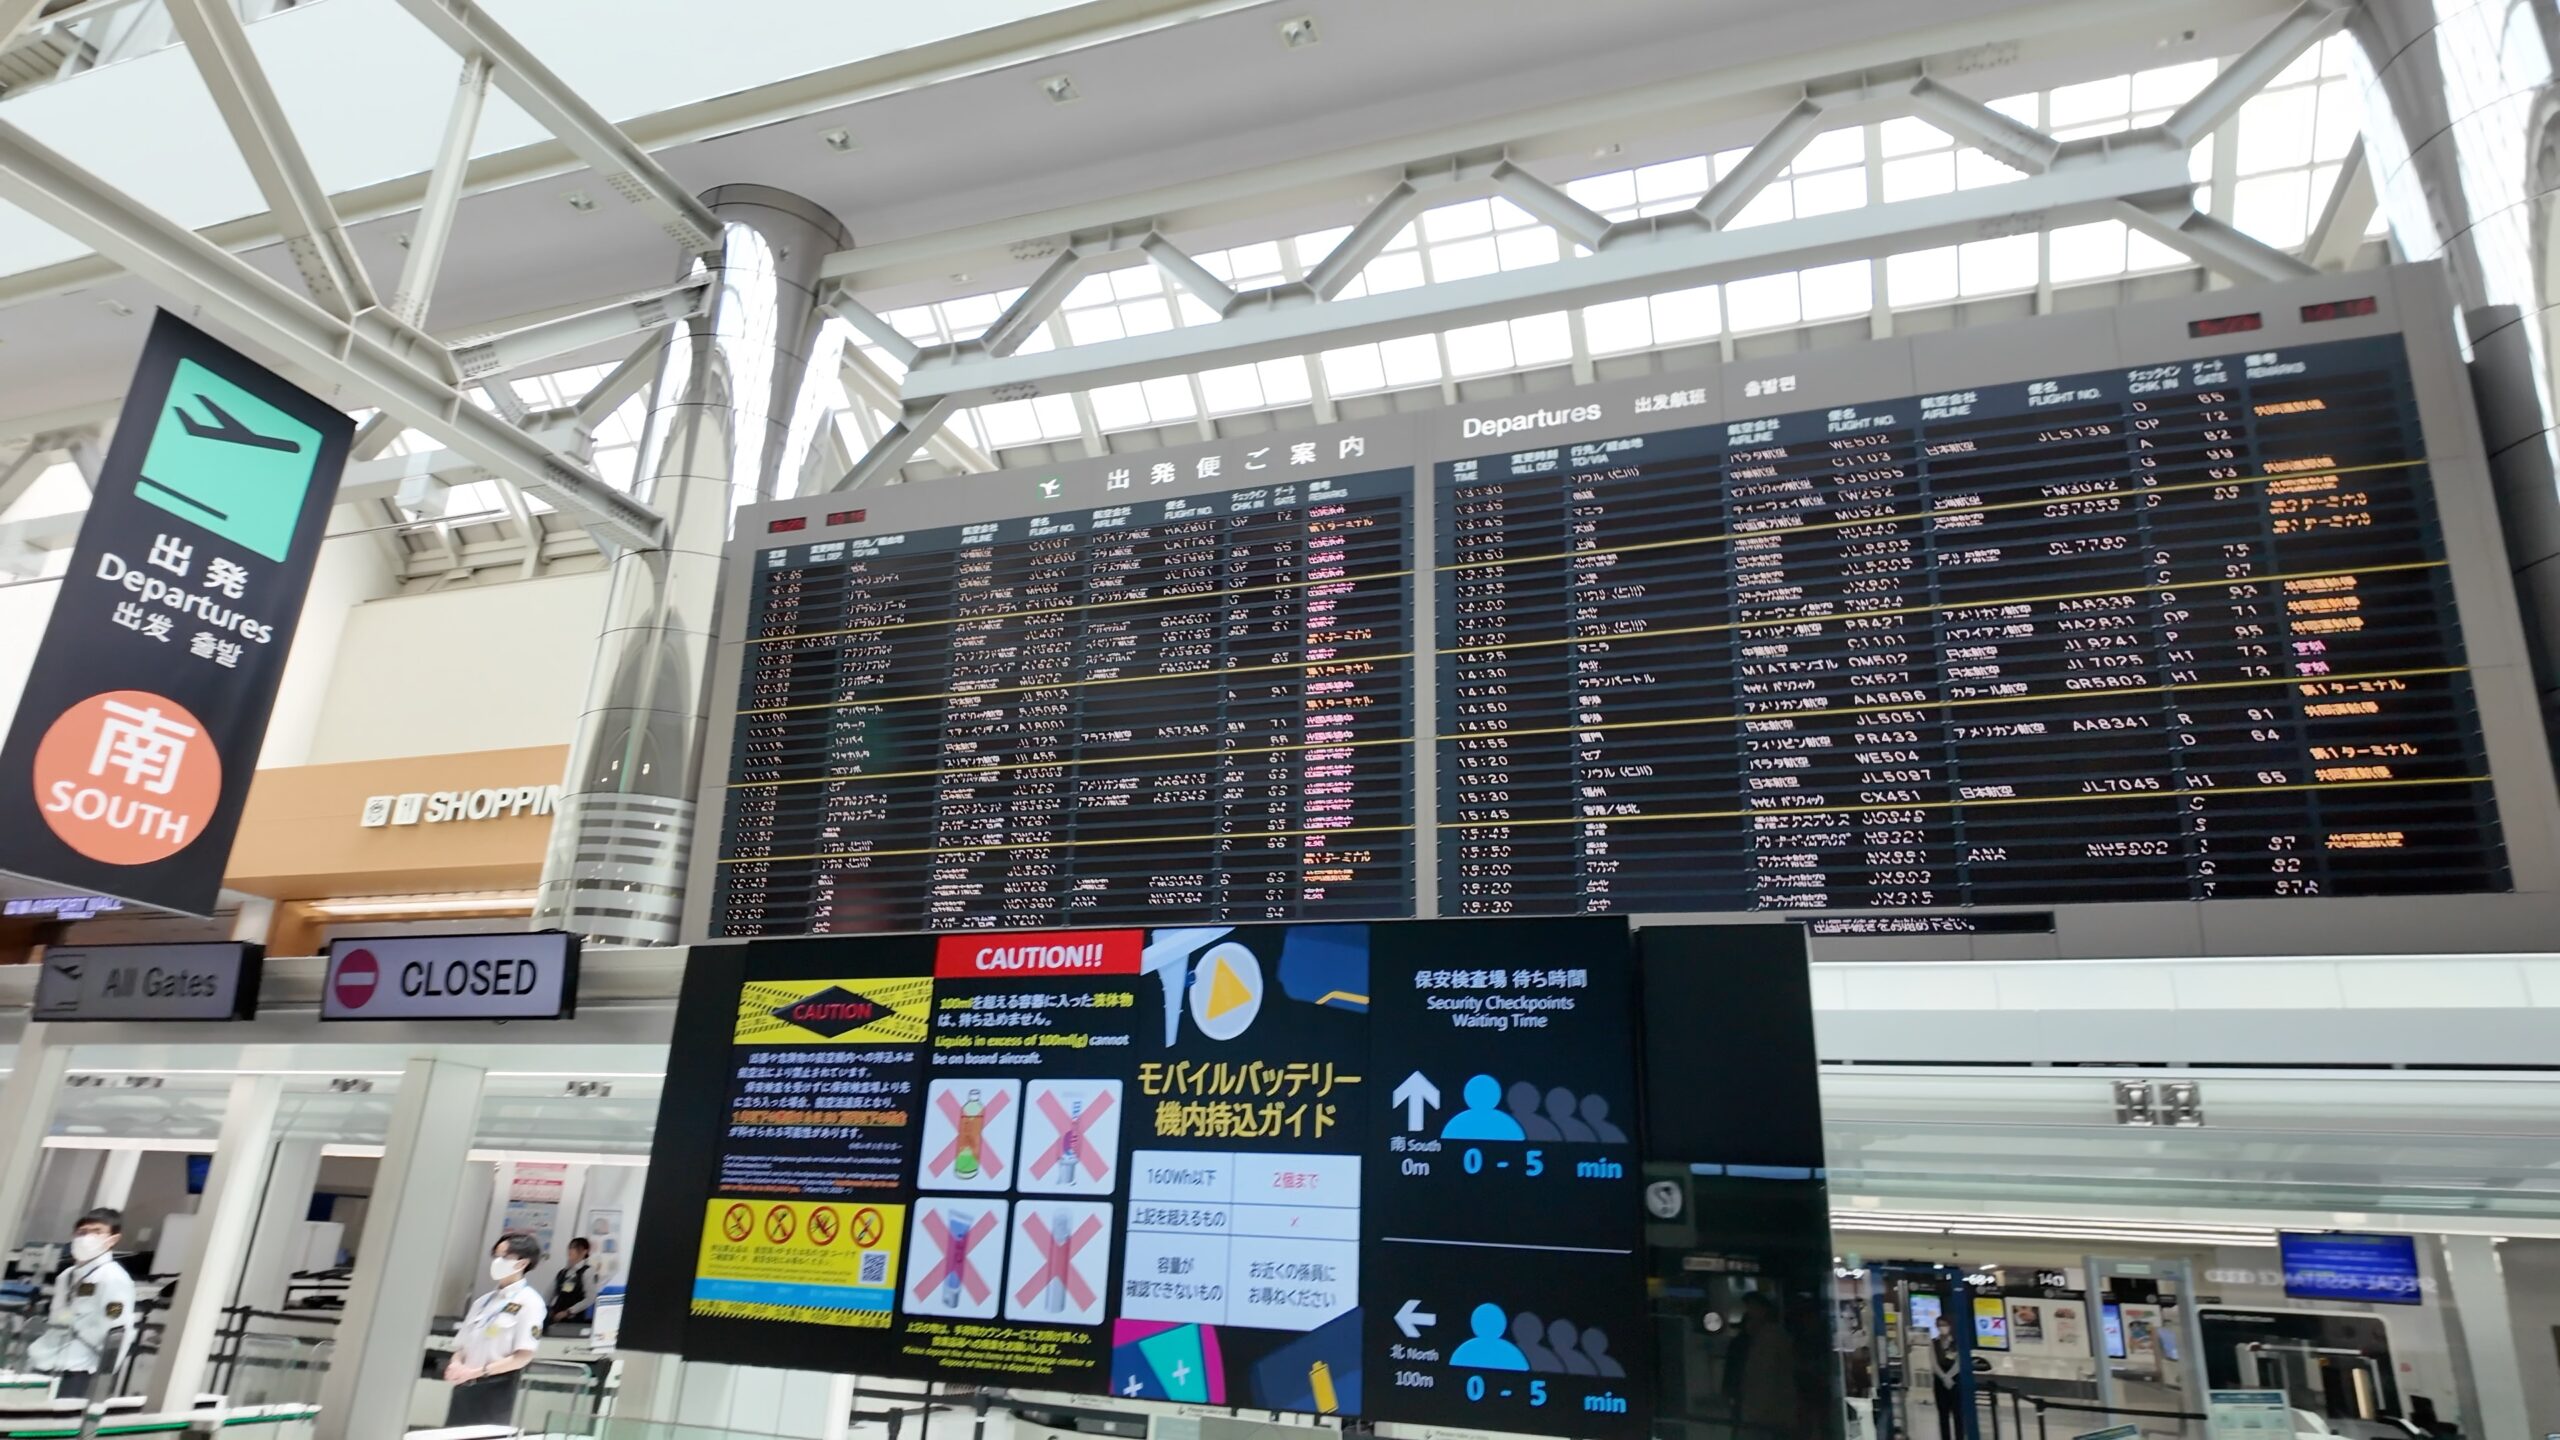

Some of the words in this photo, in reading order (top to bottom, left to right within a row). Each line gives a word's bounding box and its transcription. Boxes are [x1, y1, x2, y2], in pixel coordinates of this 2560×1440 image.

[1462, 404, 1602, 440] Departures
[96, 552, 274, 644] Departures
[112, 601, 174, 643] 出发
[190, 631, 244, 668] 출발
[1457, 668, 1507, 681] 14:30
[2065, 674, 2148, 690] QR5803
[1458, 685, 1508, 698] 14:40
[1853, 689, 1928, 706] AA8896
[1458, 702, 1508, 715] 14:50
[2247, 708, 2275, 721] 91
[1458, 719, 1508, 732] 14:50
[1856, 711, 1927, 726] JL5051
[2072, 716, 2150, 732] AA8341
[2177, 713, 2193, 726] R
[1854, 730, 1918, 745] PR433
[2180, 733, 2196, 746] D
[2250, 729, 2280, 742] 64
[88, 700, 196, 795] 南
[1458, 738, 1508, 751] 14:55
[1458, 756, 1508, 768] 15:20
[1854, 750, 1920, 765] WE504
[1459, 774, 1509, 786] 15:20
[1749, 776, 1801, 790] 日本航空
[1861, 769, 1932, 784] JL5097
[2257, 771, 2287, 784] 65
[1959, 785, 2017, 799] 日本航空
[2082, 777, 2161, 793] JL7045
[1459, 792, 1509, 804] 15:30
[1860, 789, 1922, 803] CX451
[46, 780, 189, 844] SOUTH
[1459, 809, 1510, 821] 15:45
[975, 943, 1104, 970] CAUTION!!
[105, 967, 137, 998] All
[142, 966, 219, 999] Gates
[400, 959, 537, 997] CLOSED
[1414, 970, 1508, 989] 保安検査場
[1511, 969, 1588, 989] 待ち時間
[792, 1003, 873, 1020] CAUTION
[1426, 995, 1483, 1013] Security
[1485, 996, 1575, 1013] Checkpoints
[1452, 1013, 1508, 1031] Waiting
[1511, 1013, 1548, 1028] Time
[1137, 1060, 1361, 1098] モバイルバッテリー
[1154, 1100, 1336, 1138] 機内持込ガイド
[1407, 1139, 1441, 1152] South
[1401, 1158, 1430, 1176] 0m
[1463, 1148, 1483, 1174] 0
[1525, 1150, 1543, 1176] 5
[1576, 1158, 1623, 1178] min
[1406, 1347, 1439, 1361] North
[1394, 1371, 1433, 1388] 100m
[1466, 1375, 1484, 1401] 0
[1529, 1380, 1547, 1406] 5
[1583, 1391, 1627, 1413] min
